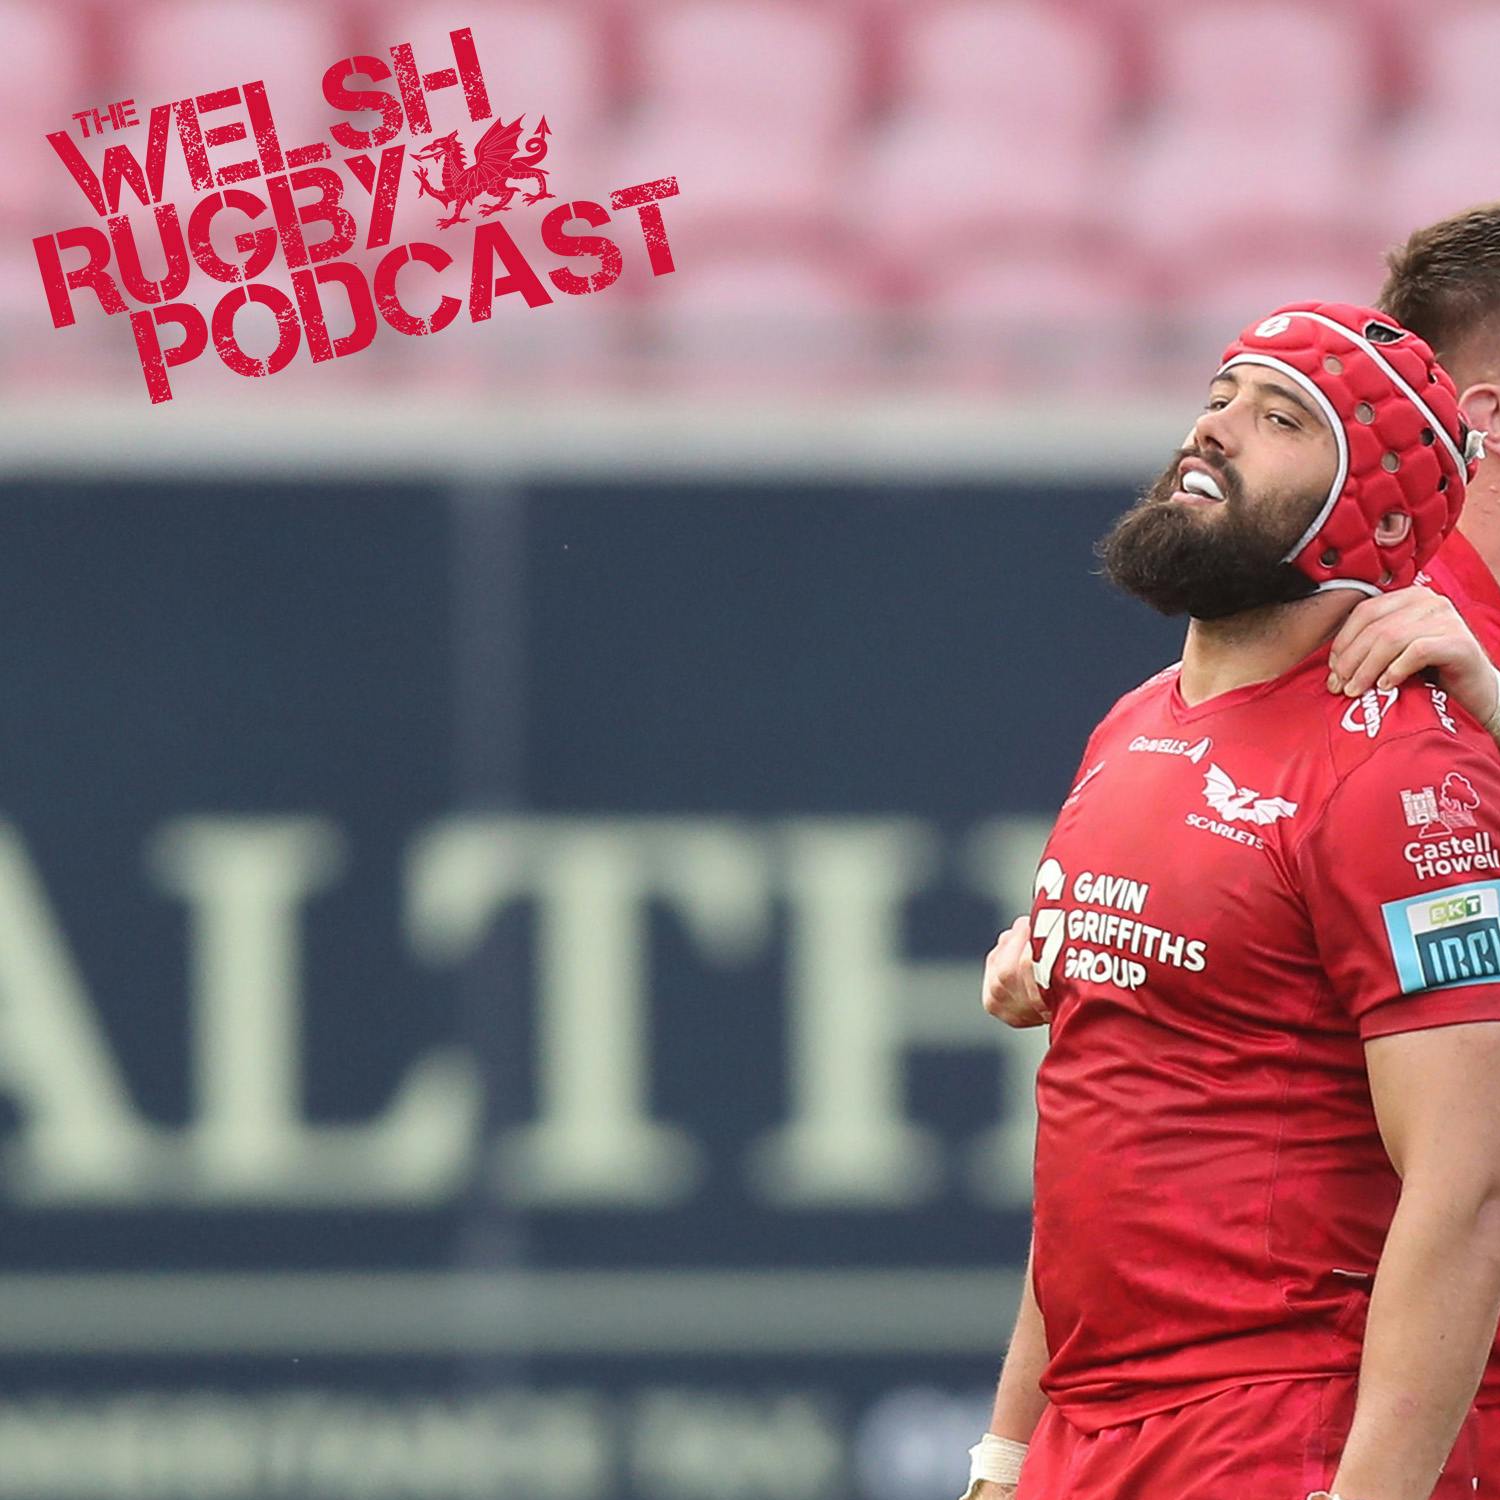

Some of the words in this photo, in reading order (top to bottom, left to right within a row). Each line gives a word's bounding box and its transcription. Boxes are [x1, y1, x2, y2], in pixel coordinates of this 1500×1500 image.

[1184, 813, 1265, 850] SCARLETS
[1404, 832, 1491, 864] Castell
[1415, 850, 1500, 880] Howell
[1072, 871, 1150, 914] GAVIN
[1430, 897, 1481, 924] BKT
[1067, 908, 1207, 972] GRIFFITHS
[1064, 947, 1147, 991] GROUP
